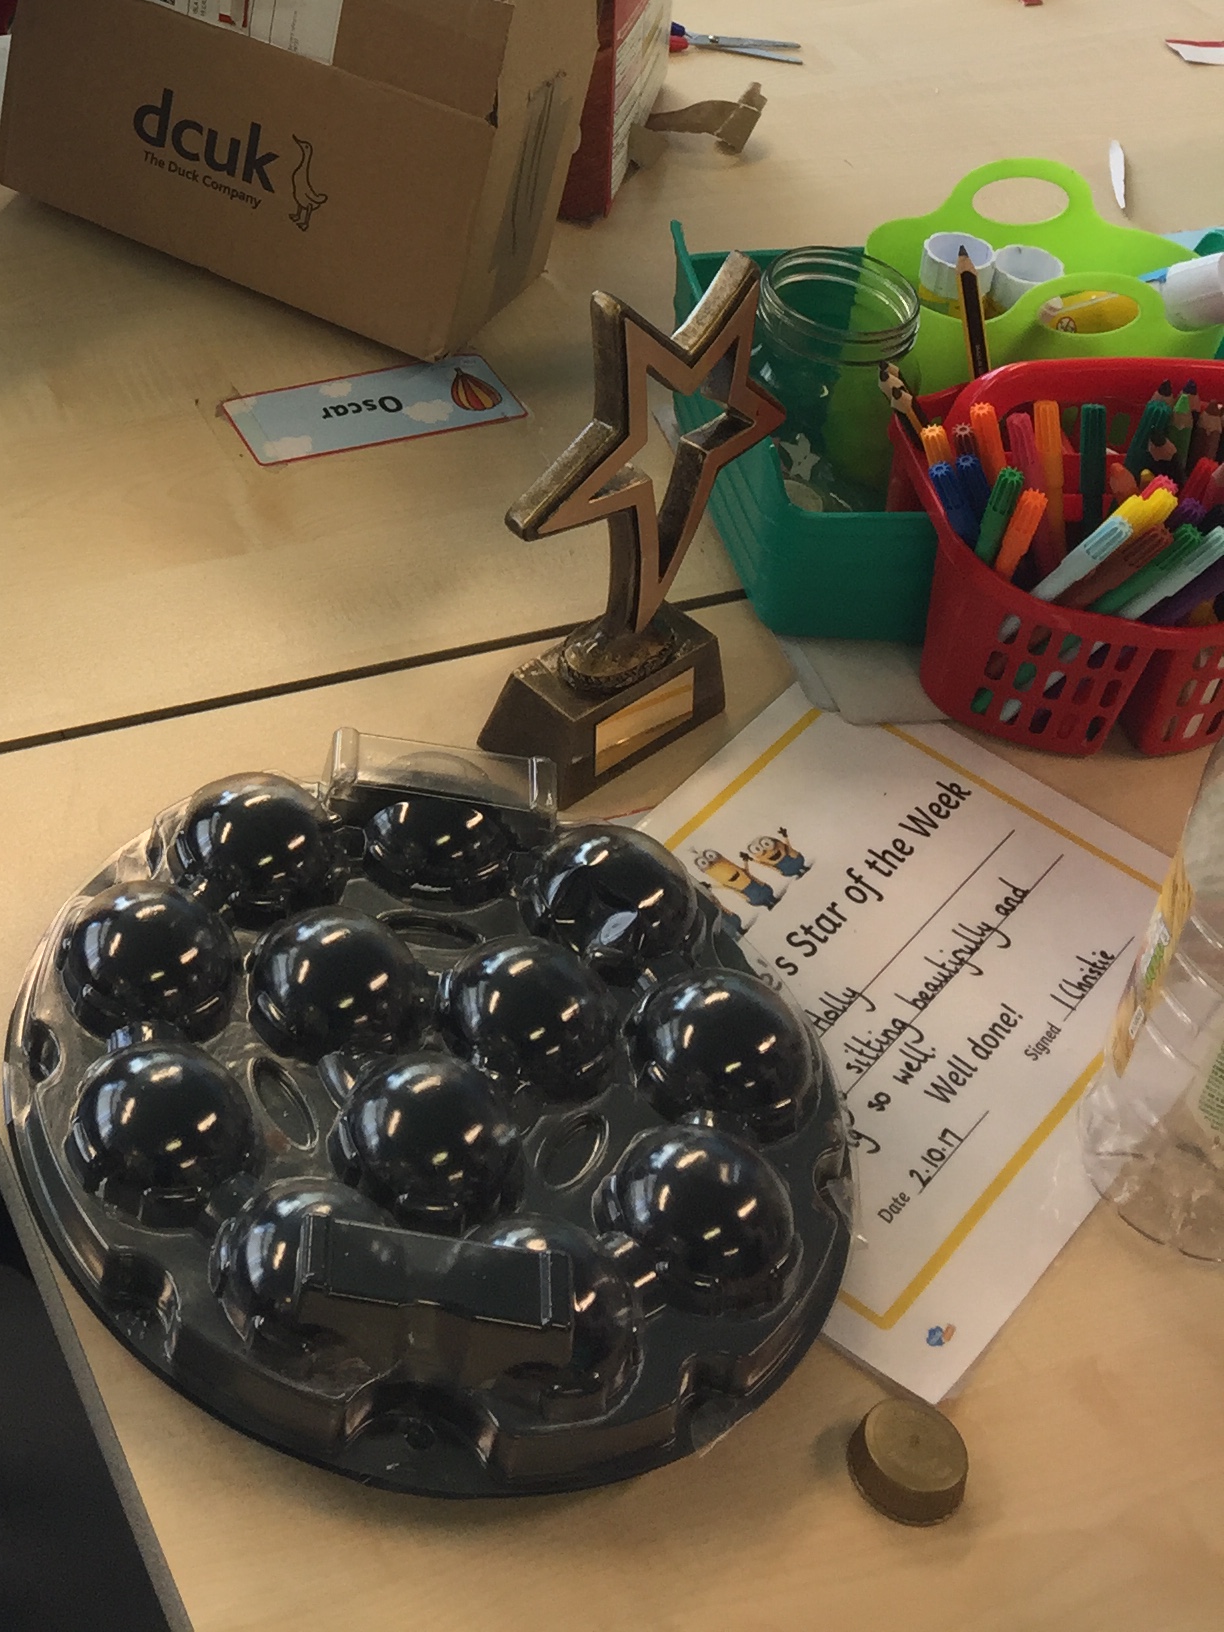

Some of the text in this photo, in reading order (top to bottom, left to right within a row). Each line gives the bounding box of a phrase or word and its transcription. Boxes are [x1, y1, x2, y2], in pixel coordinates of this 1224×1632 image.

[133, 87, 280, 194] dcuk
[143, 150, 263, 210] The Duck Company
[322, 395, 404, 420] Oscar
[785, 901, 848, 958] Star
[844, 867, 884, 904] of
[864, 837, 915, 878] the
[898, 780, 972, 838] Week
[845, 1016, 925, 1075] sitting
[894, 922, 1012, 1012] beautifully
[994, 876, 1030, 918] and
[804, 986, 877, 1032] Holly
[923, 1002, 1024, 1104] Well done!
[1024, 1021, 1062, 1062] Signed
[867, 1091, 892, 1112] so
[877, 1191, 911, 1224] Date
